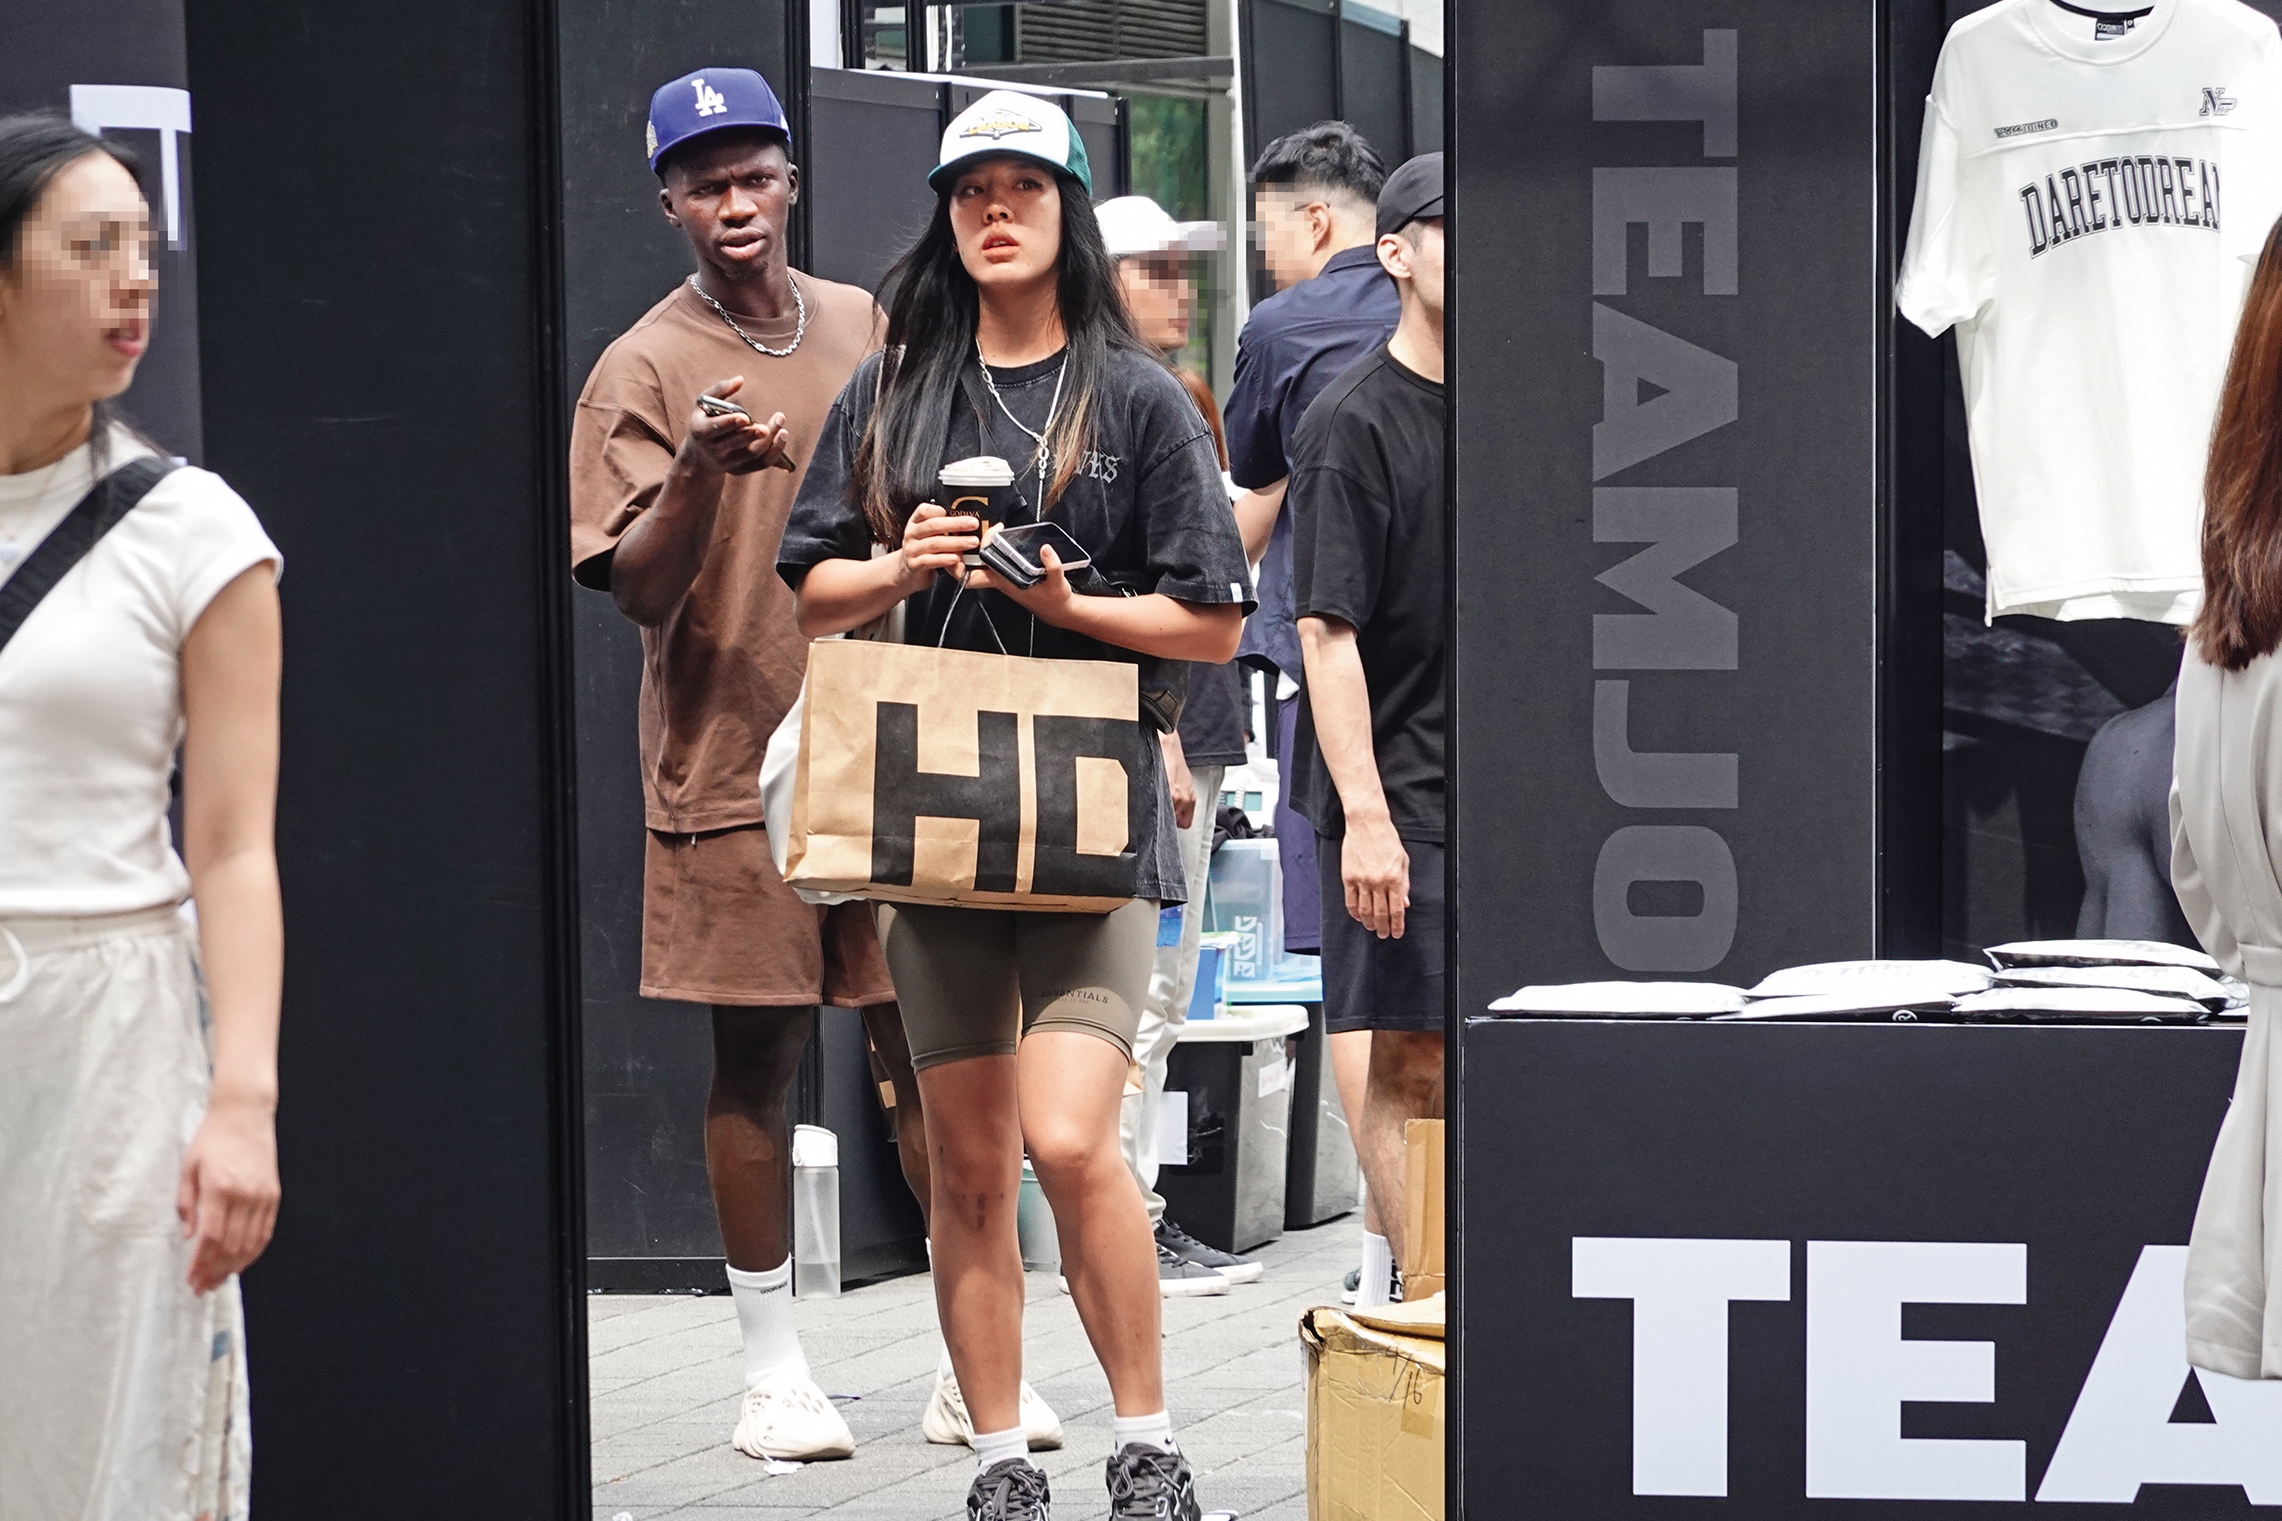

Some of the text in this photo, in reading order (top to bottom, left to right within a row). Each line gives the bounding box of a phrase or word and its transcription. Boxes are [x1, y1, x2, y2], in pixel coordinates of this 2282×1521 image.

[691, 78, 728, 117] LA
[2019, 155, 2220, 260] DARETODREA
[1592, 28, 1739, 972] TEAMJO
